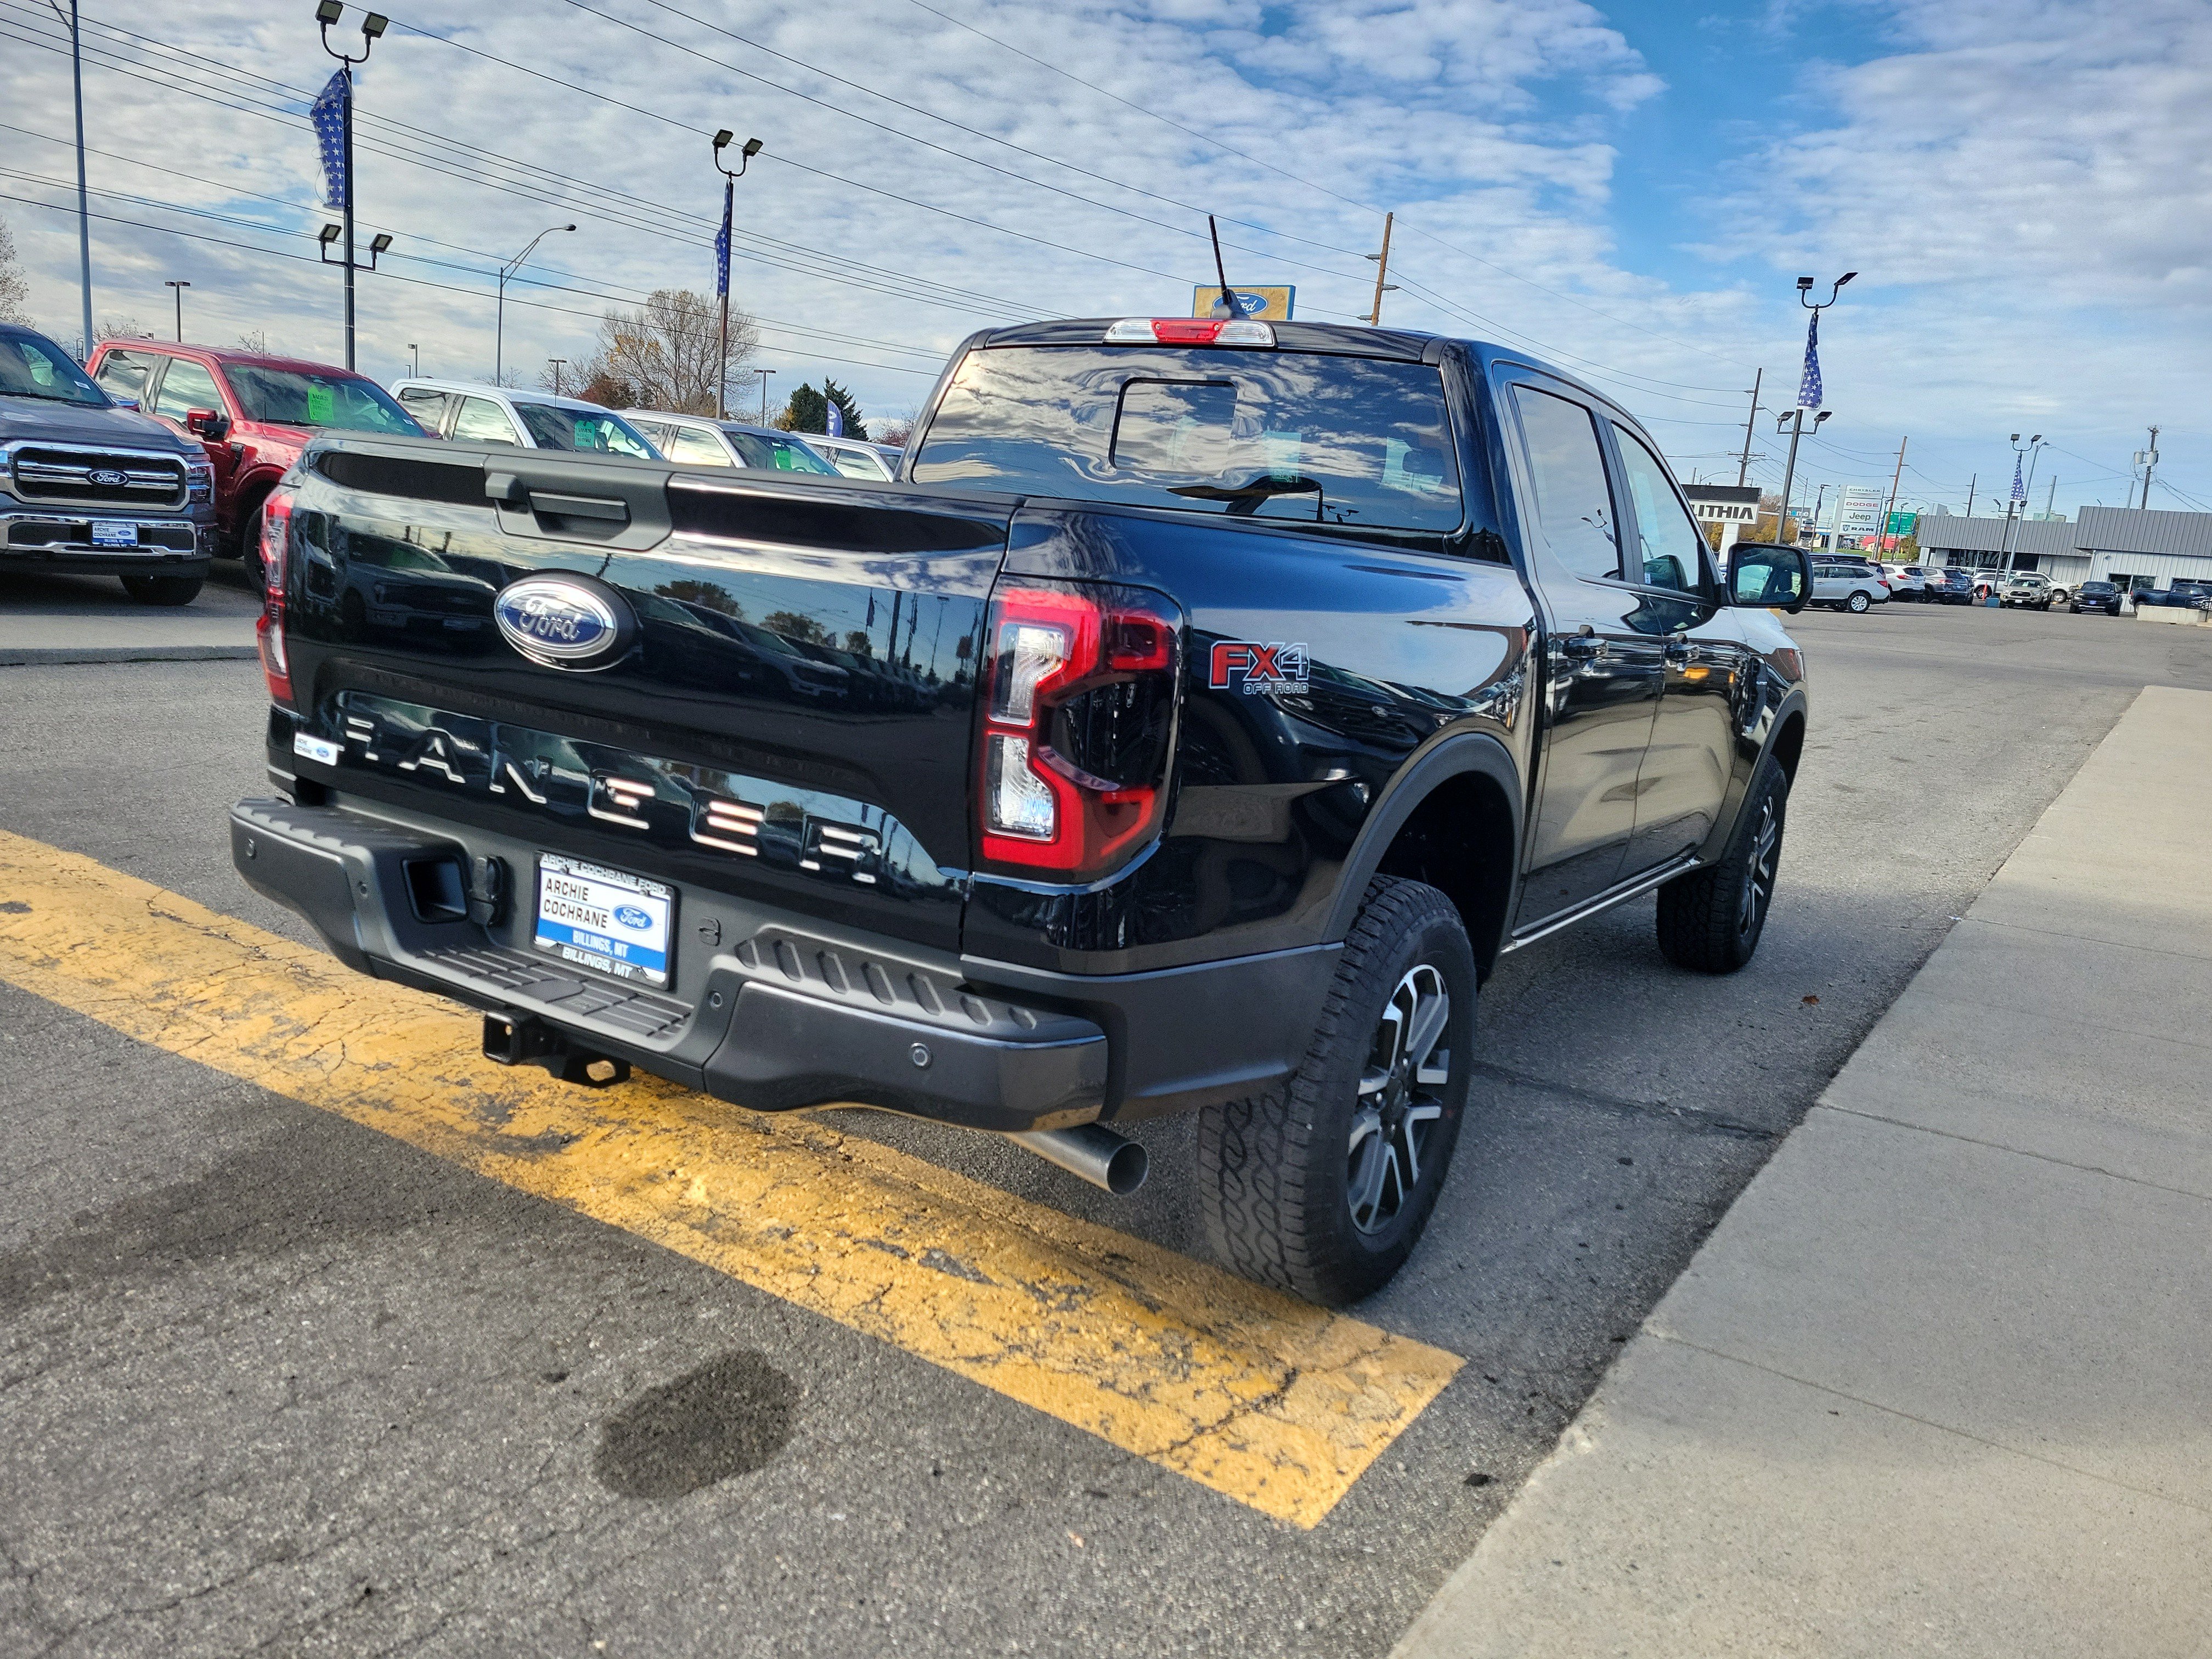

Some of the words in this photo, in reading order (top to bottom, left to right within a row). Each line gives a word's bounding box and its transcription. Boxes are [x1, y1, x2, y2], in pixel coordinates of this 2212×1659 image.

[97, 472, 120, 483] Ford
[1849, 512, 1871, 521] Jeep
[520, 596, 583, 641] Ford
[1210, 640, 1310, 689] FX4
[1243, 682, 1272, 695] OFF
[1274, 682, 1309, 695] ROAD
[541, 854, 579, 870] ARCHIE
[582, 863, 636, 886] COCHRANE
[638, 877, 666, 894] FORD
[545, 878, 589, 901] ARCHIE
[544, 898, 608, 928] COCHRANE
[619, 908, 647, 928] Ford
[572, 929, 613, 956] BILLINGS,
[614, 941, 629, 958] MT
[562, 946, 612, 974] BILLINGS,
[613, 962, 633, 978] MT
